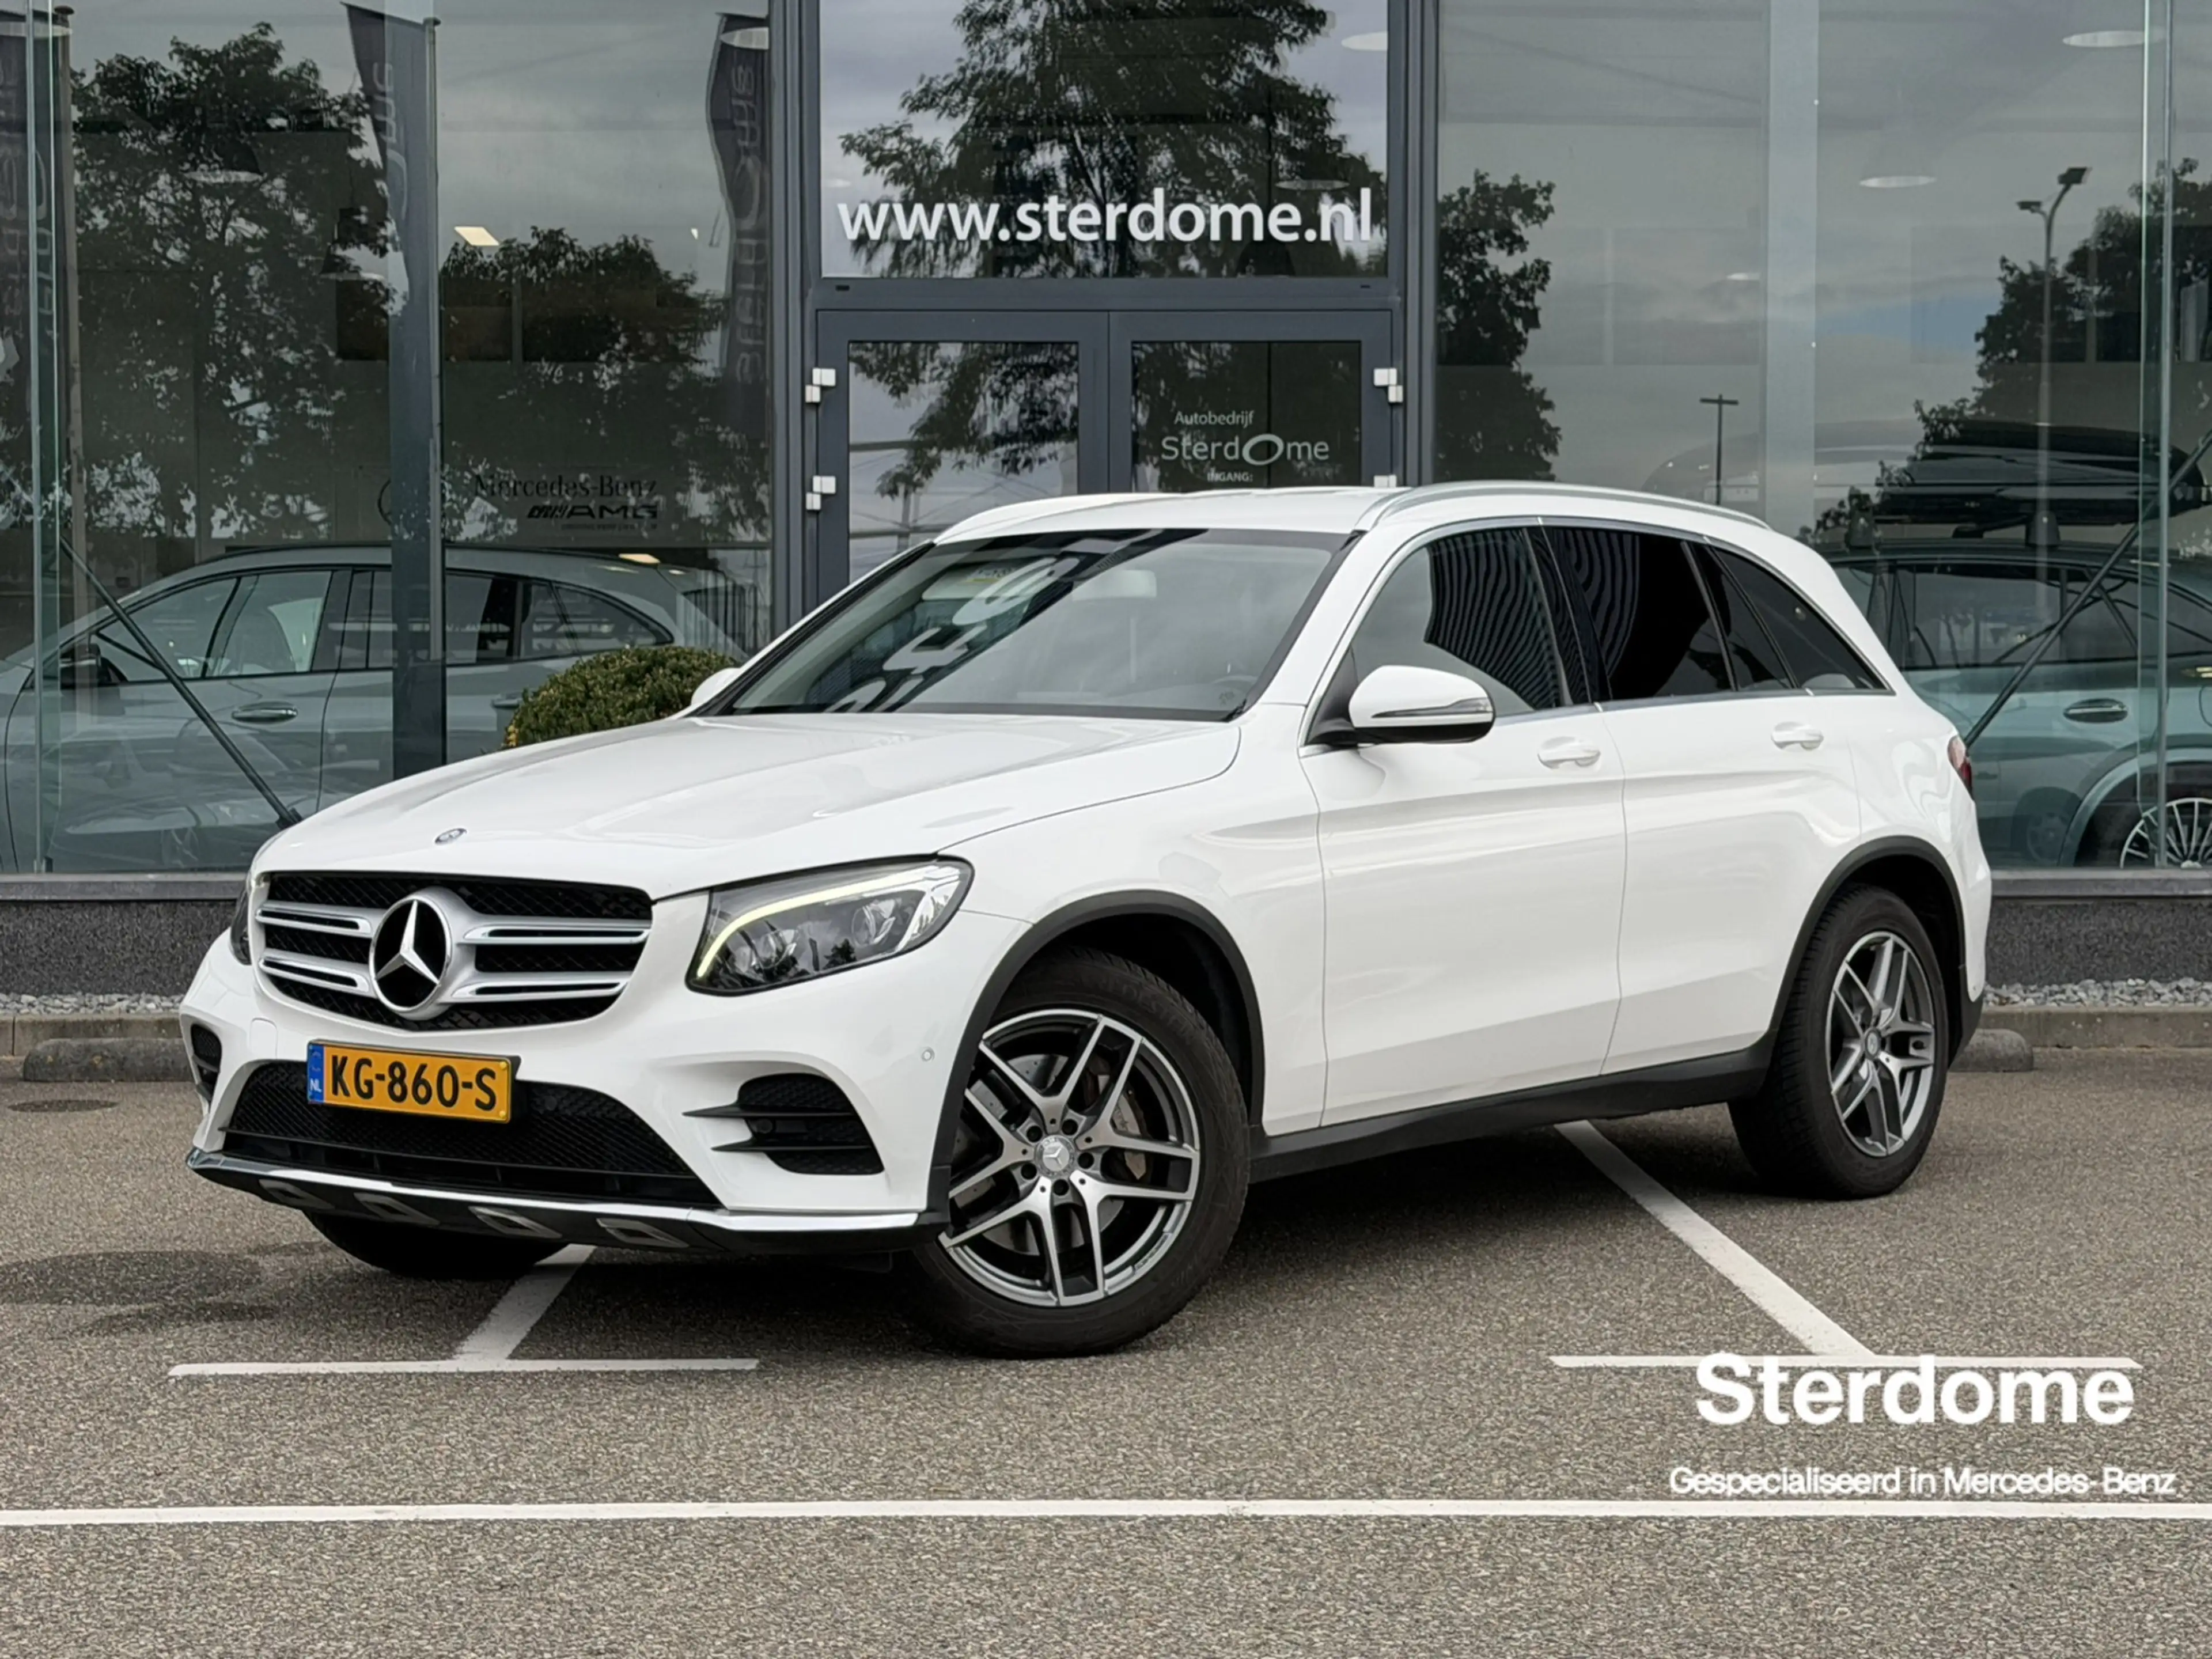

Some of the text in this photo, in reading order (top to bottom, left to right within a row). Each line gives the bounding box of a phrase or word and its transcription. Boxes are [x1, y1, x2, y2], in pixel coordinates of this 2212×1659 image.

[837, 187, 1372, 242] www.sterdome.nl
[1174, 410, 1255, 428] Autobedrijf
[474, 474, 657, 498] Mercedes-Benz
[309, 1078, 323, 1093] NL
[331, 1054, 497, 1112] KG-860-S
